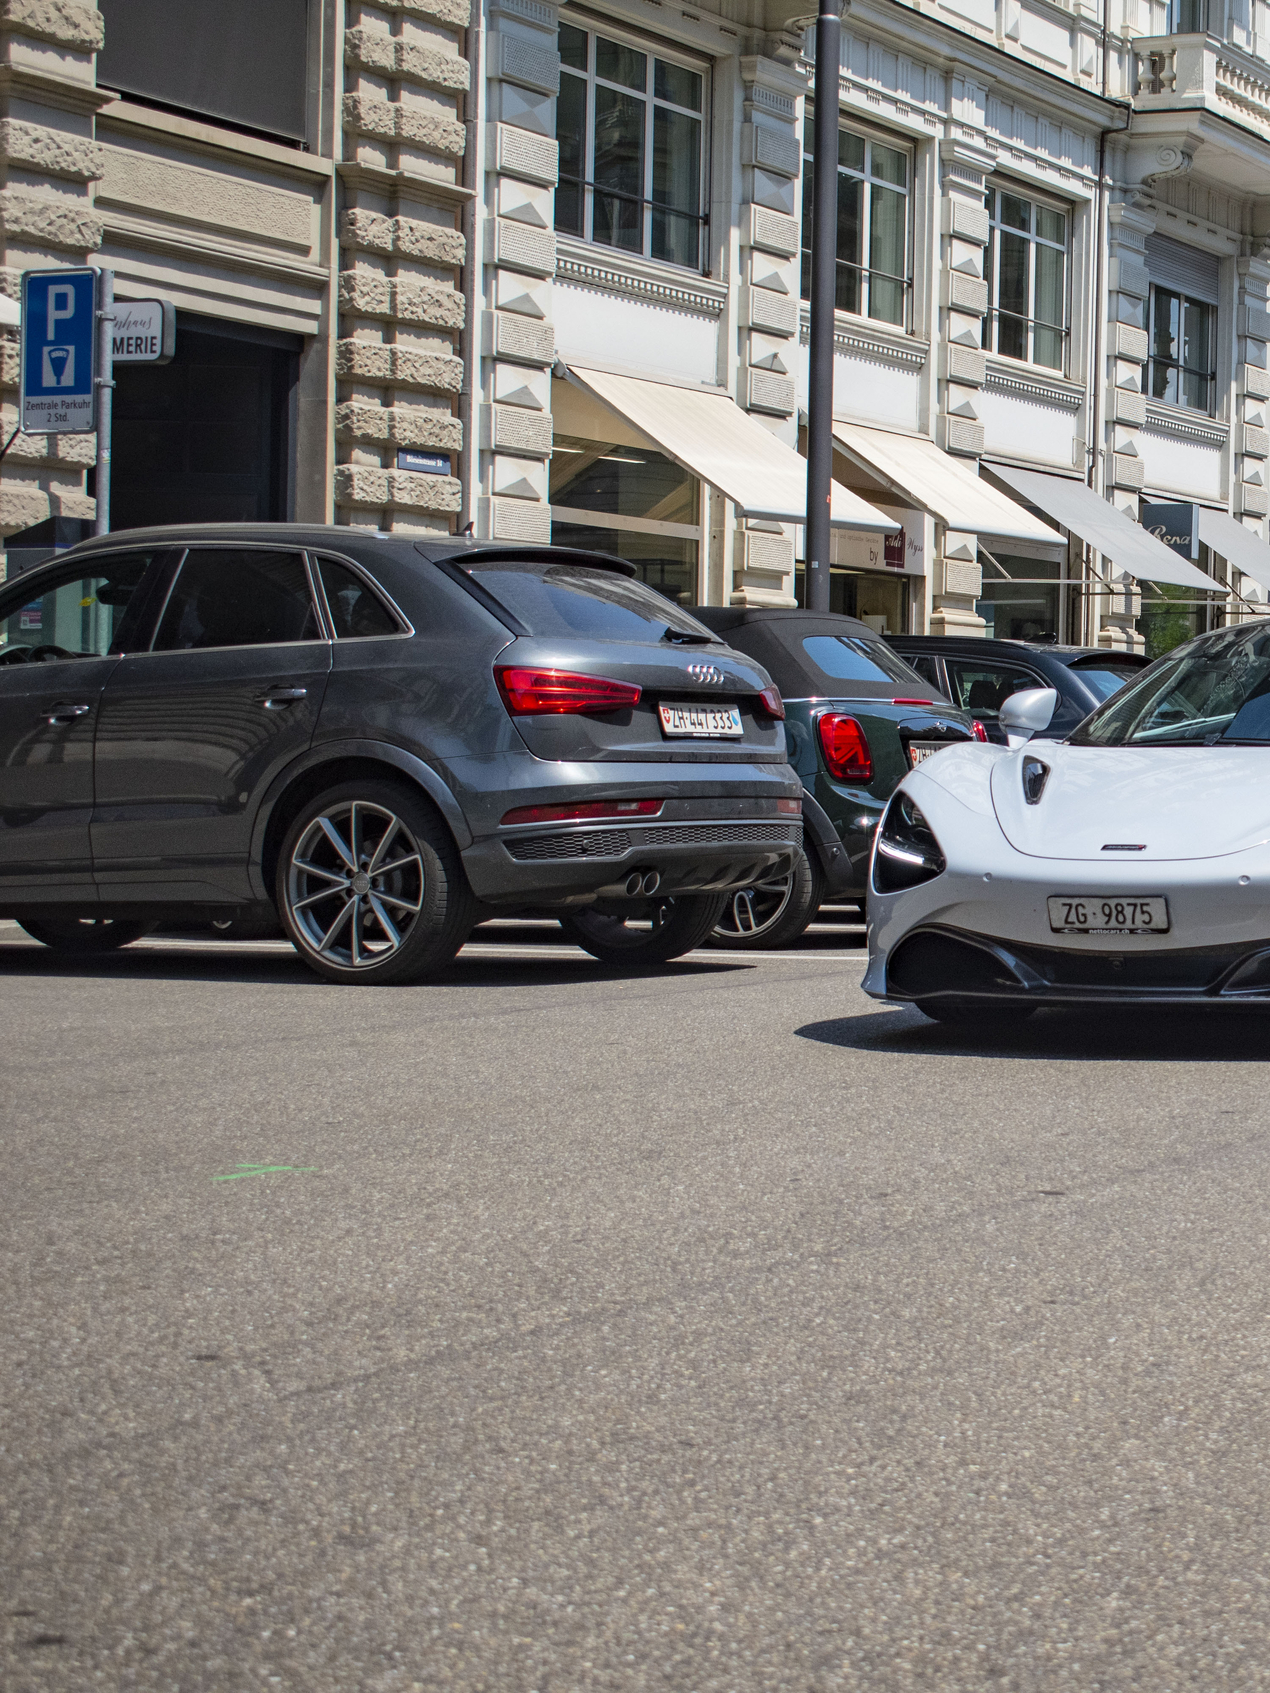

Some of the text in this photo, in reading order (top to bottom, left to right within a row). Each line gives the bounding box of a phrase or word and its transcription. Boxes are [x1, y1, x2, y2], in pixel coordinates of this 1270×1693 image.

[46, 284, 76, 341] P
[26, 400, 91, 411] Zentrale Parkuhr
[47, 412, 69, 423] 2 Std.
[1147, 524, 1191, 545] Rena
[869, 547, 879, 565] by
[906, 537, 924, 557] Wyss
